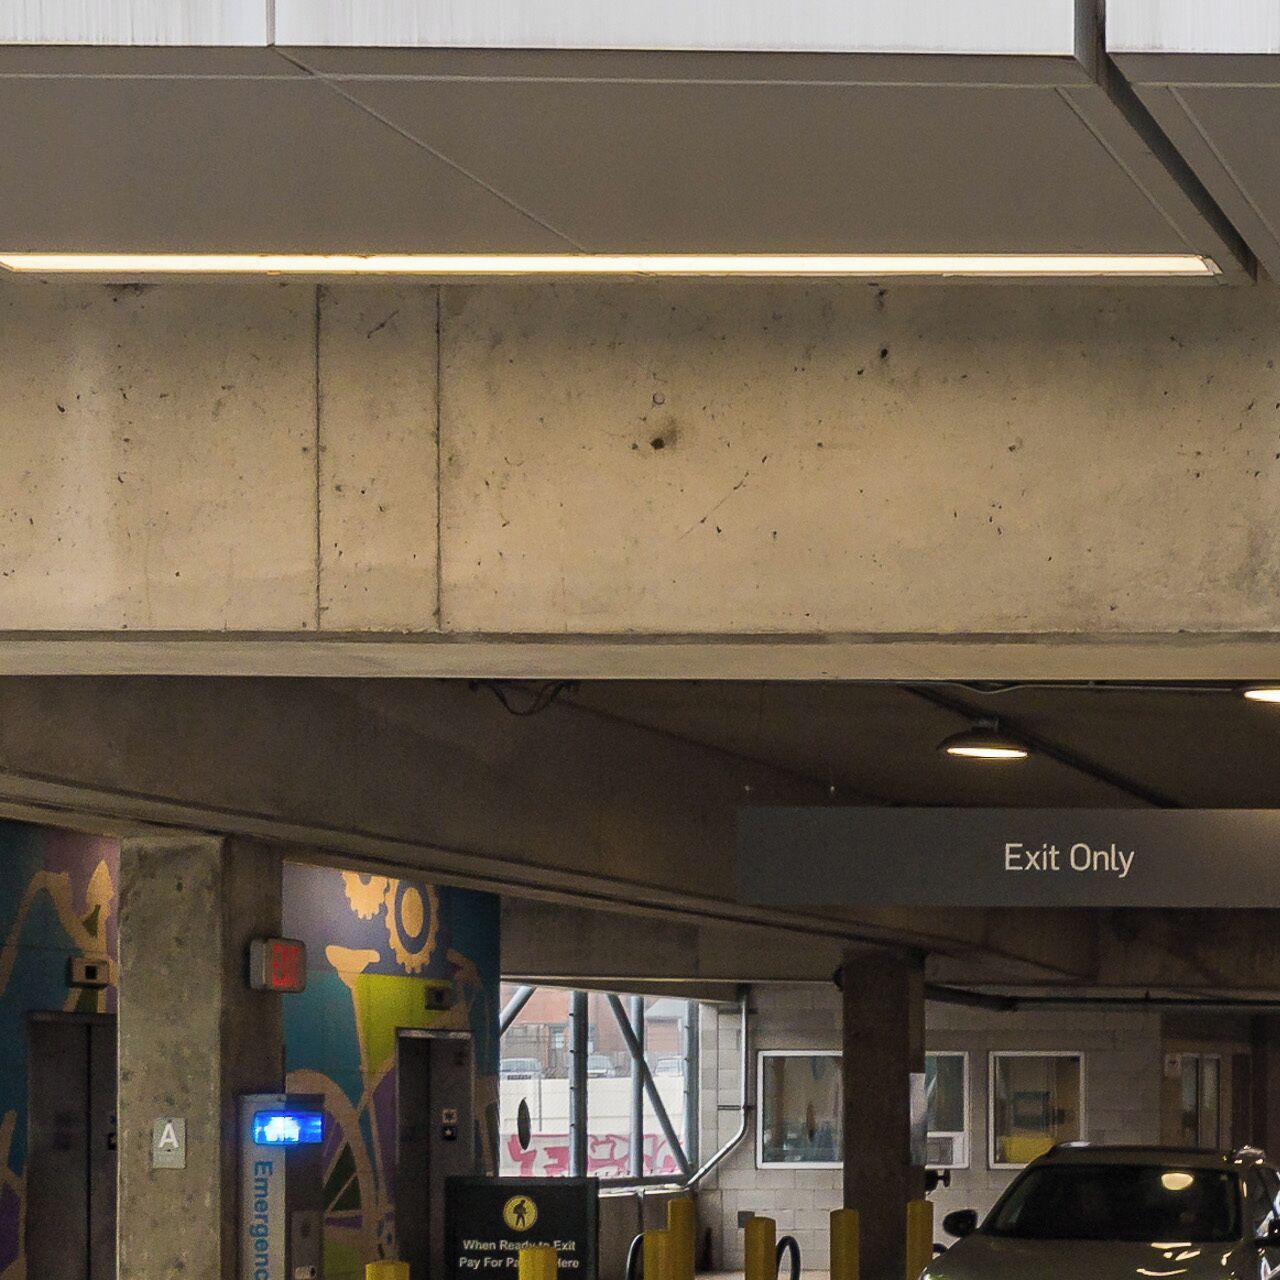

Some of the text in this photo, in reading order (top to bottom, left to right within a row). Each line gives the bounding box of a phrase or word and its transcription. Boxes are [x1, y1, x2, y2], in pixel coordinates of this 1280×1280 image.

[1005, 842, 1135, 878] Exit Only
[158, 1122, 180, 1149] A
[463, 1239, 496, 1251] When
[553, 1239, 576, 1251] Exit
[459, 1257, 481, 1270] Pay
[484, 1257, 501, 1268] For
